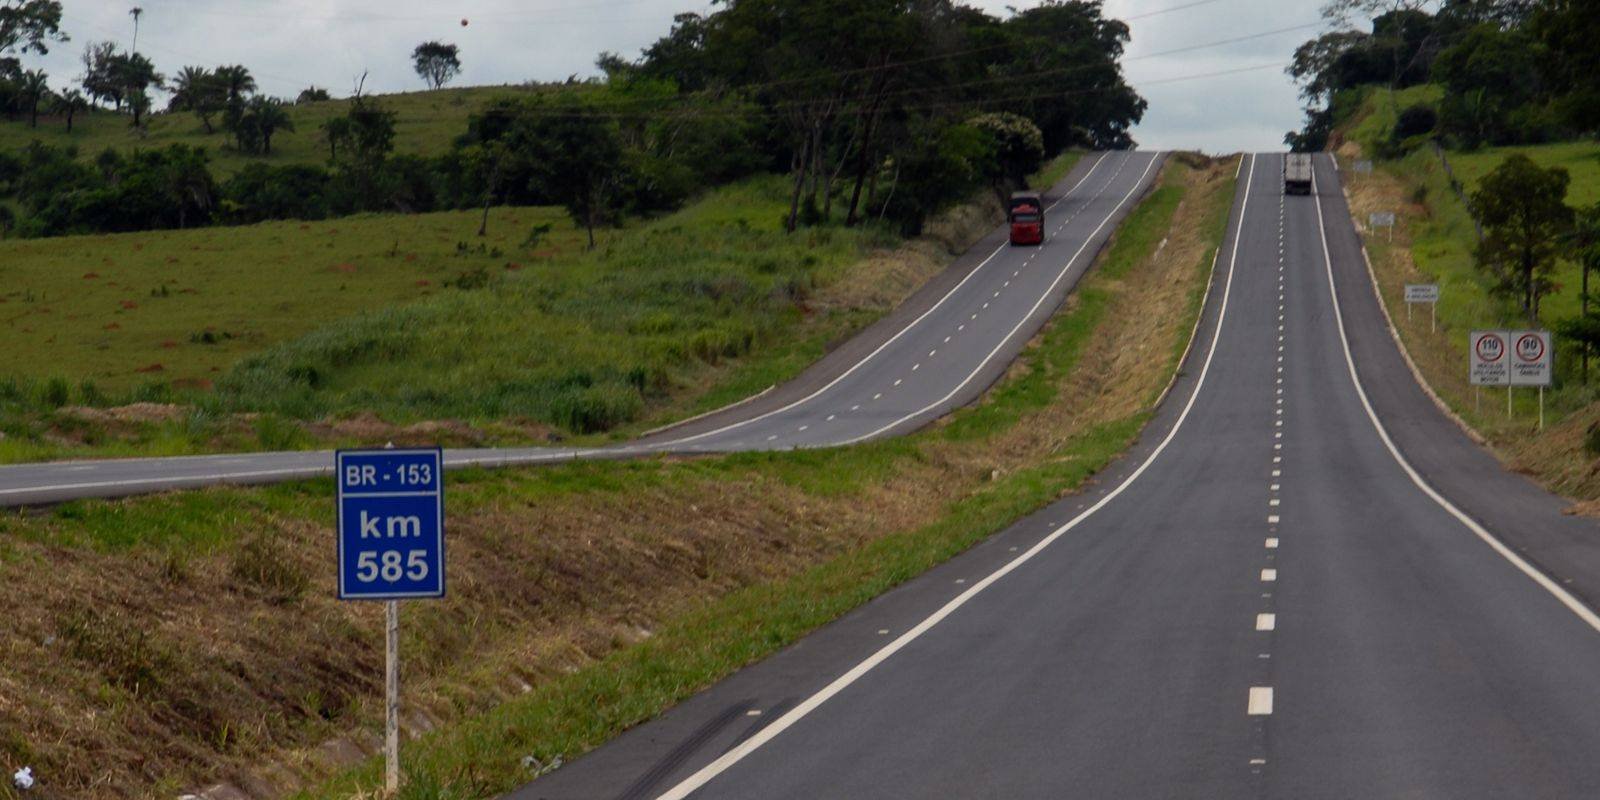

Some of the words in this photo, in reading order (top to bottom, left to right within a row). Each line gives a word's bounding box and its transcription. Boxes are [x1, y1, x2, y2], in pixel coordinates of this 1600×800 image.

[1482, 339, 1498, 350] 110
[1523, 339, 1537, 350] 90
[346, 465, 377, 486] BR
[396, 464, 432, 485] 153
[360, 510, 421, 538] km
[356, 549, 429, 583] 585
